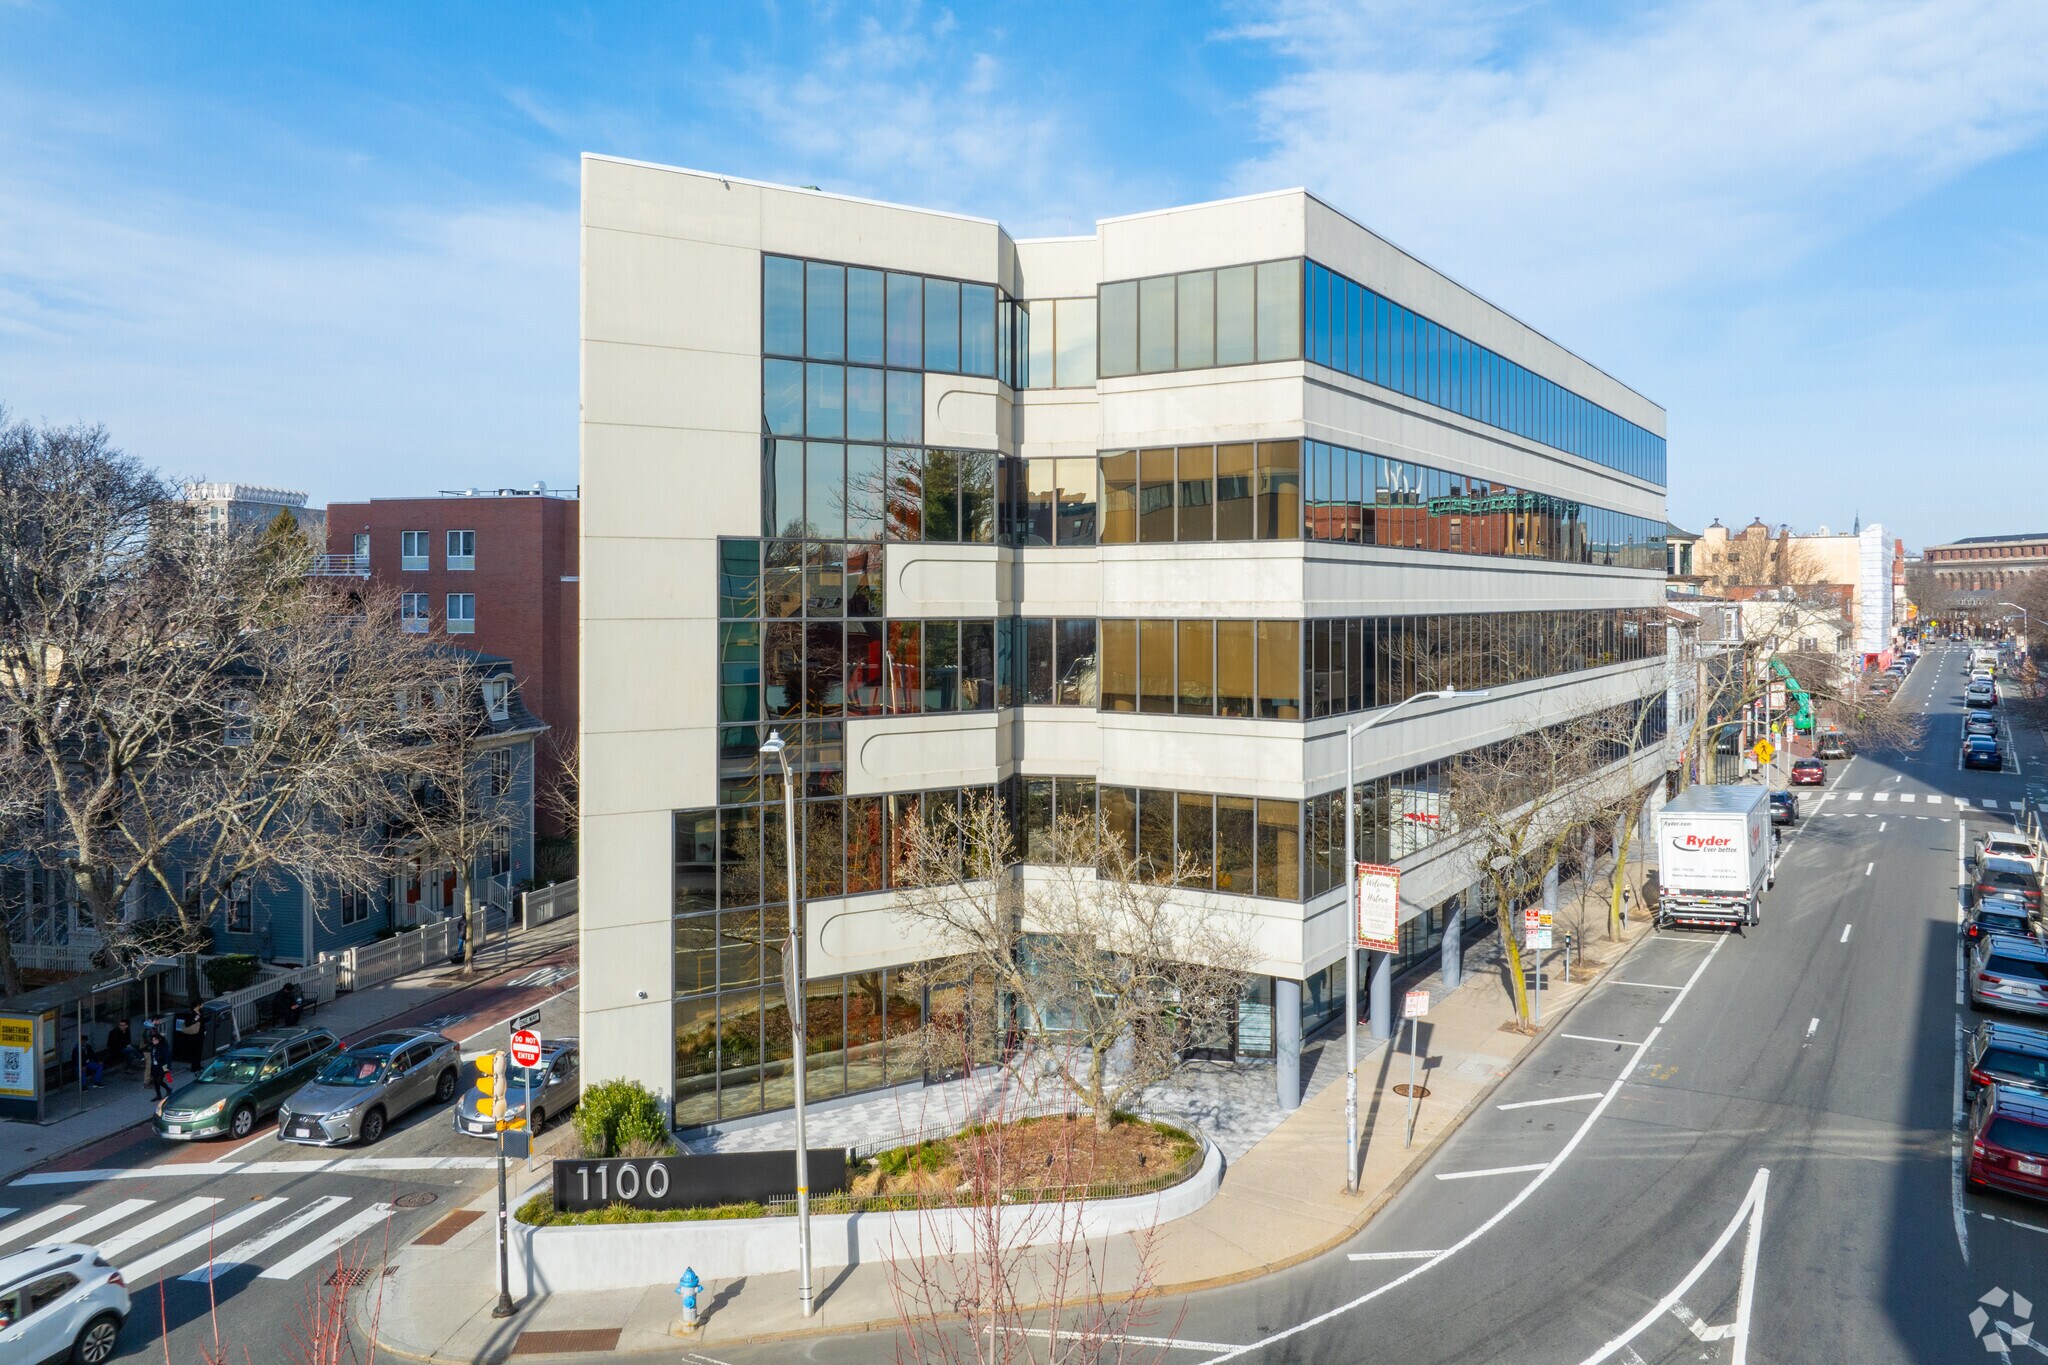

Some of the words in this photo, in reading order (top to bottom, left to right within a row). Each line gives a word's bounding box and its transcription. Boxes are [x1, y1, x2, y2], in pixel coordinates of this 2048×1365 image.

[1686, 835, 1731, 848] Ryder
[1366, 878, 1390, 888] Welcome
[1367, 893, 1389, 904] Historic
[515, 1035, 523, 1043] DO
[525, 1037, 536, 1045] NOT
[517, 1052, 535, 1061] ENTER
[577, 1162, 669, 1200] 1100
